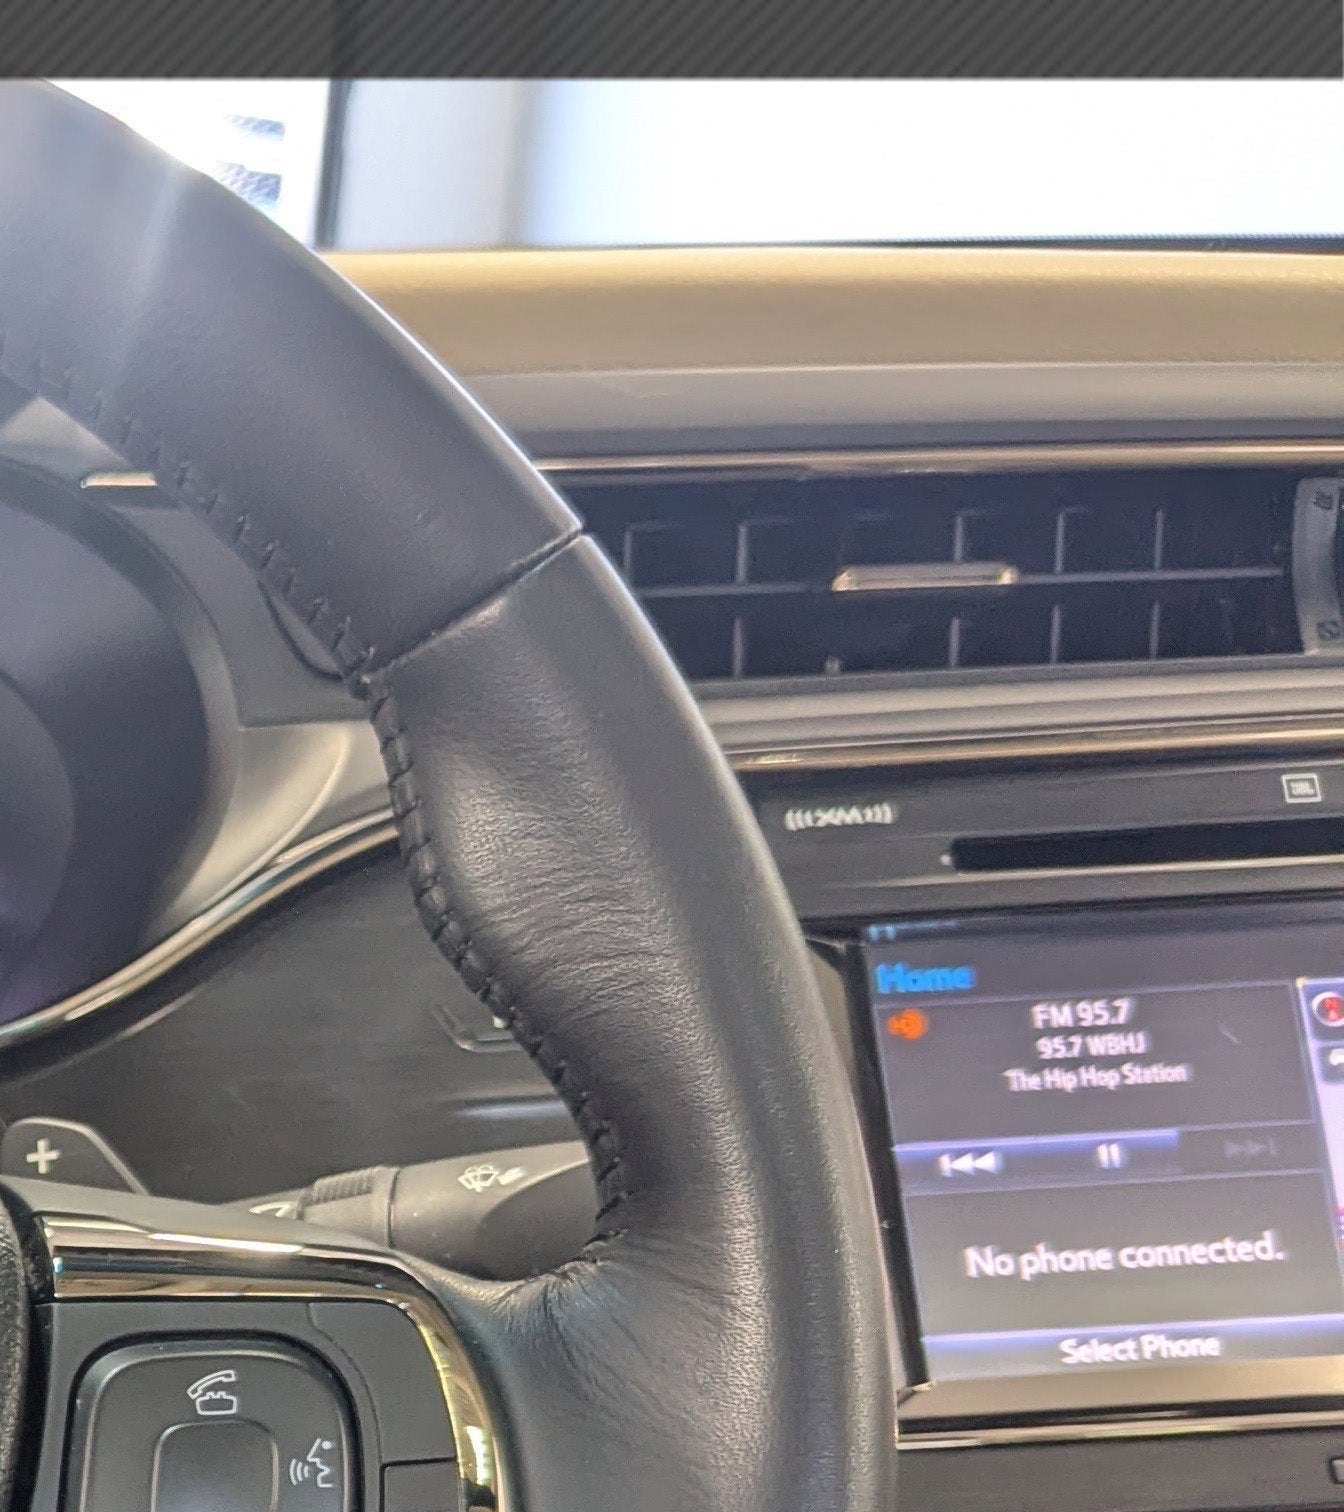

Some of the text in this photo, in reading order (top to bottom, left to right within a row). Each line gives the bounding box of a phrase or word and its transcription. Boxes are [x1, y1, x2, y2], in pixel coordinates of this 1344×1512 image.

[875, 961, 975, 994] Home
[1032, 998, 1131, 1029] FM 95.7
[1037, 1034, 1083, 1060] 95.7
[1004, 1061, 1189, 1094] The Hip Hop Station
[965, 1230, 1286, 1281] No phone connected.
[1060, 1332, 1221, 1364] Select Phone
